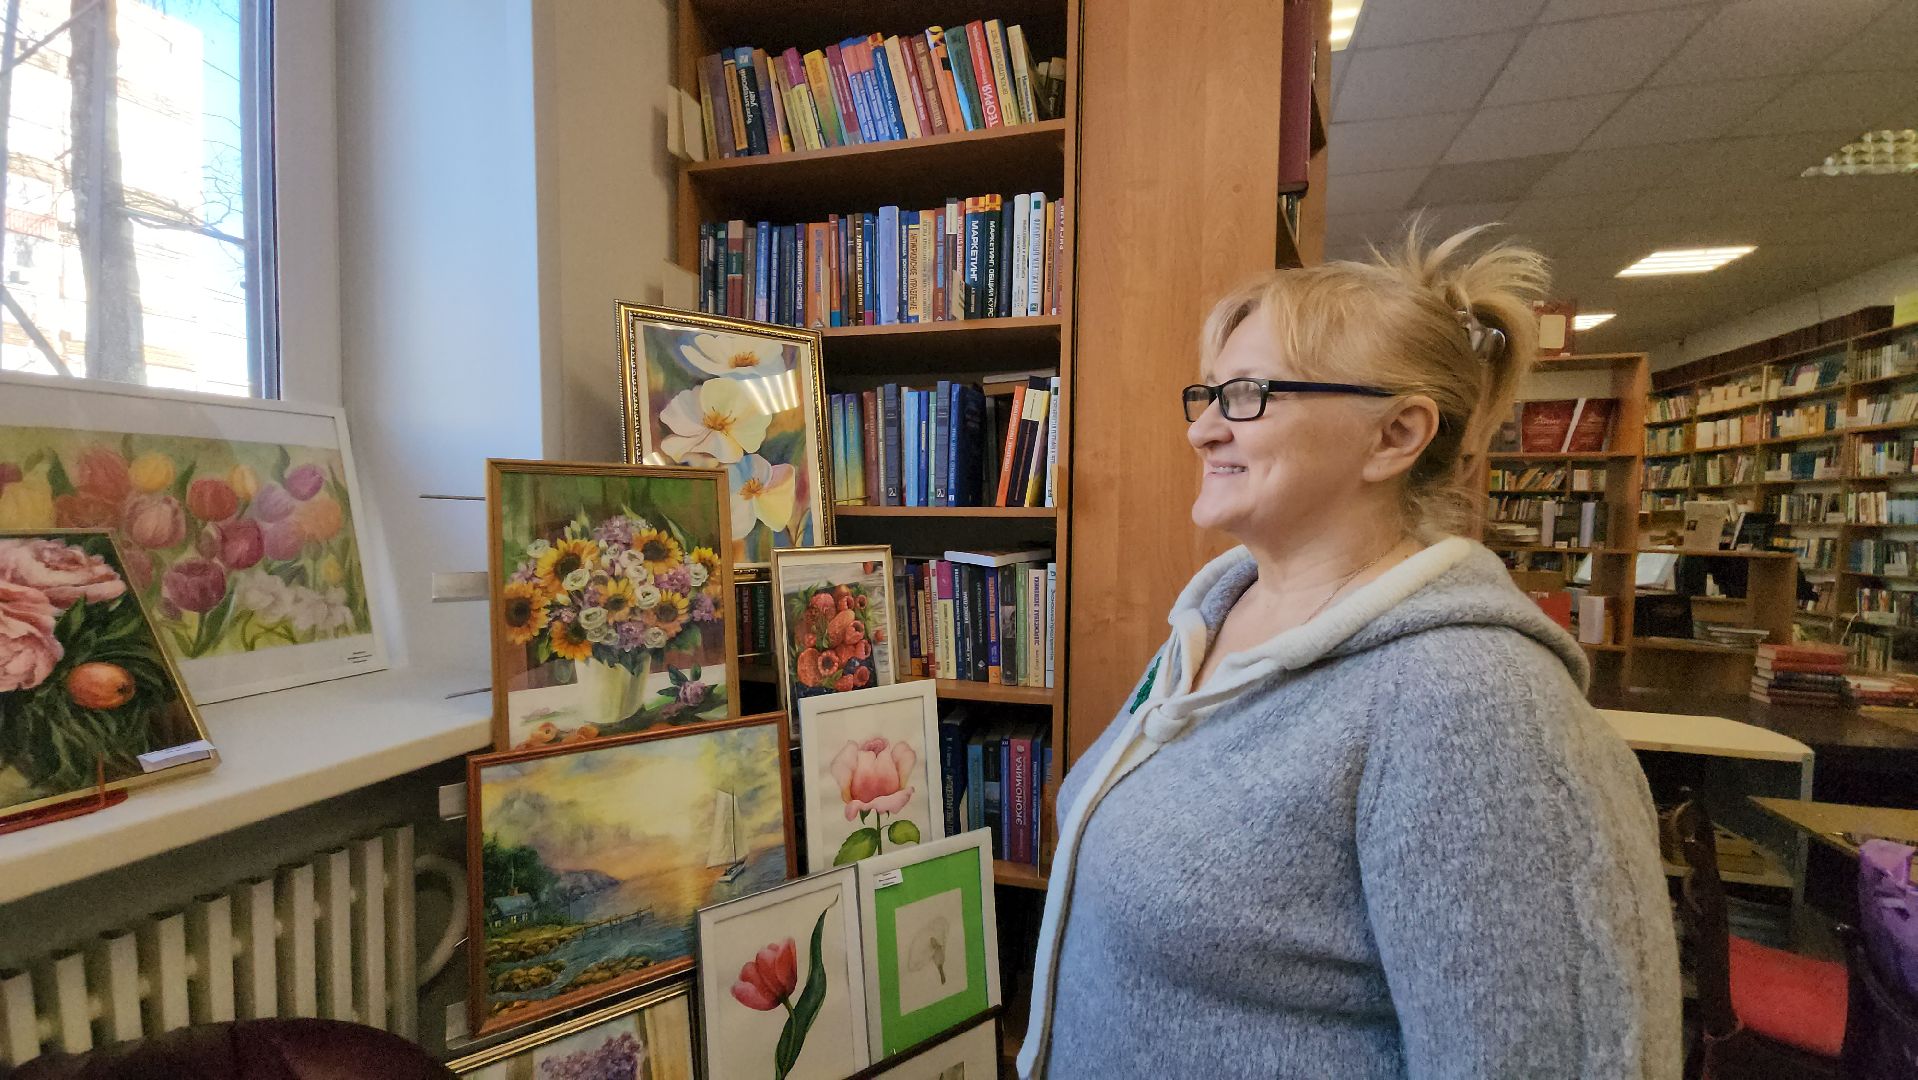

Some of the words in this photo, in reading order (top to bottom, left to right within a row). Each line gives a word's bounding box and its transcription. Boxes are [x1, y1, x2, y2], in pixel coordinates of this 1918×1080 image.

[982, 83, 998, 127] ТЕОРИЯ
[909, 233, 917, 275] АНТИКРИЗИСНОЕ
[970, 220, 978, 281] МАРКЕТИНГ
[909, 277, 917, 309] УПРАВЛЕНИЕ
